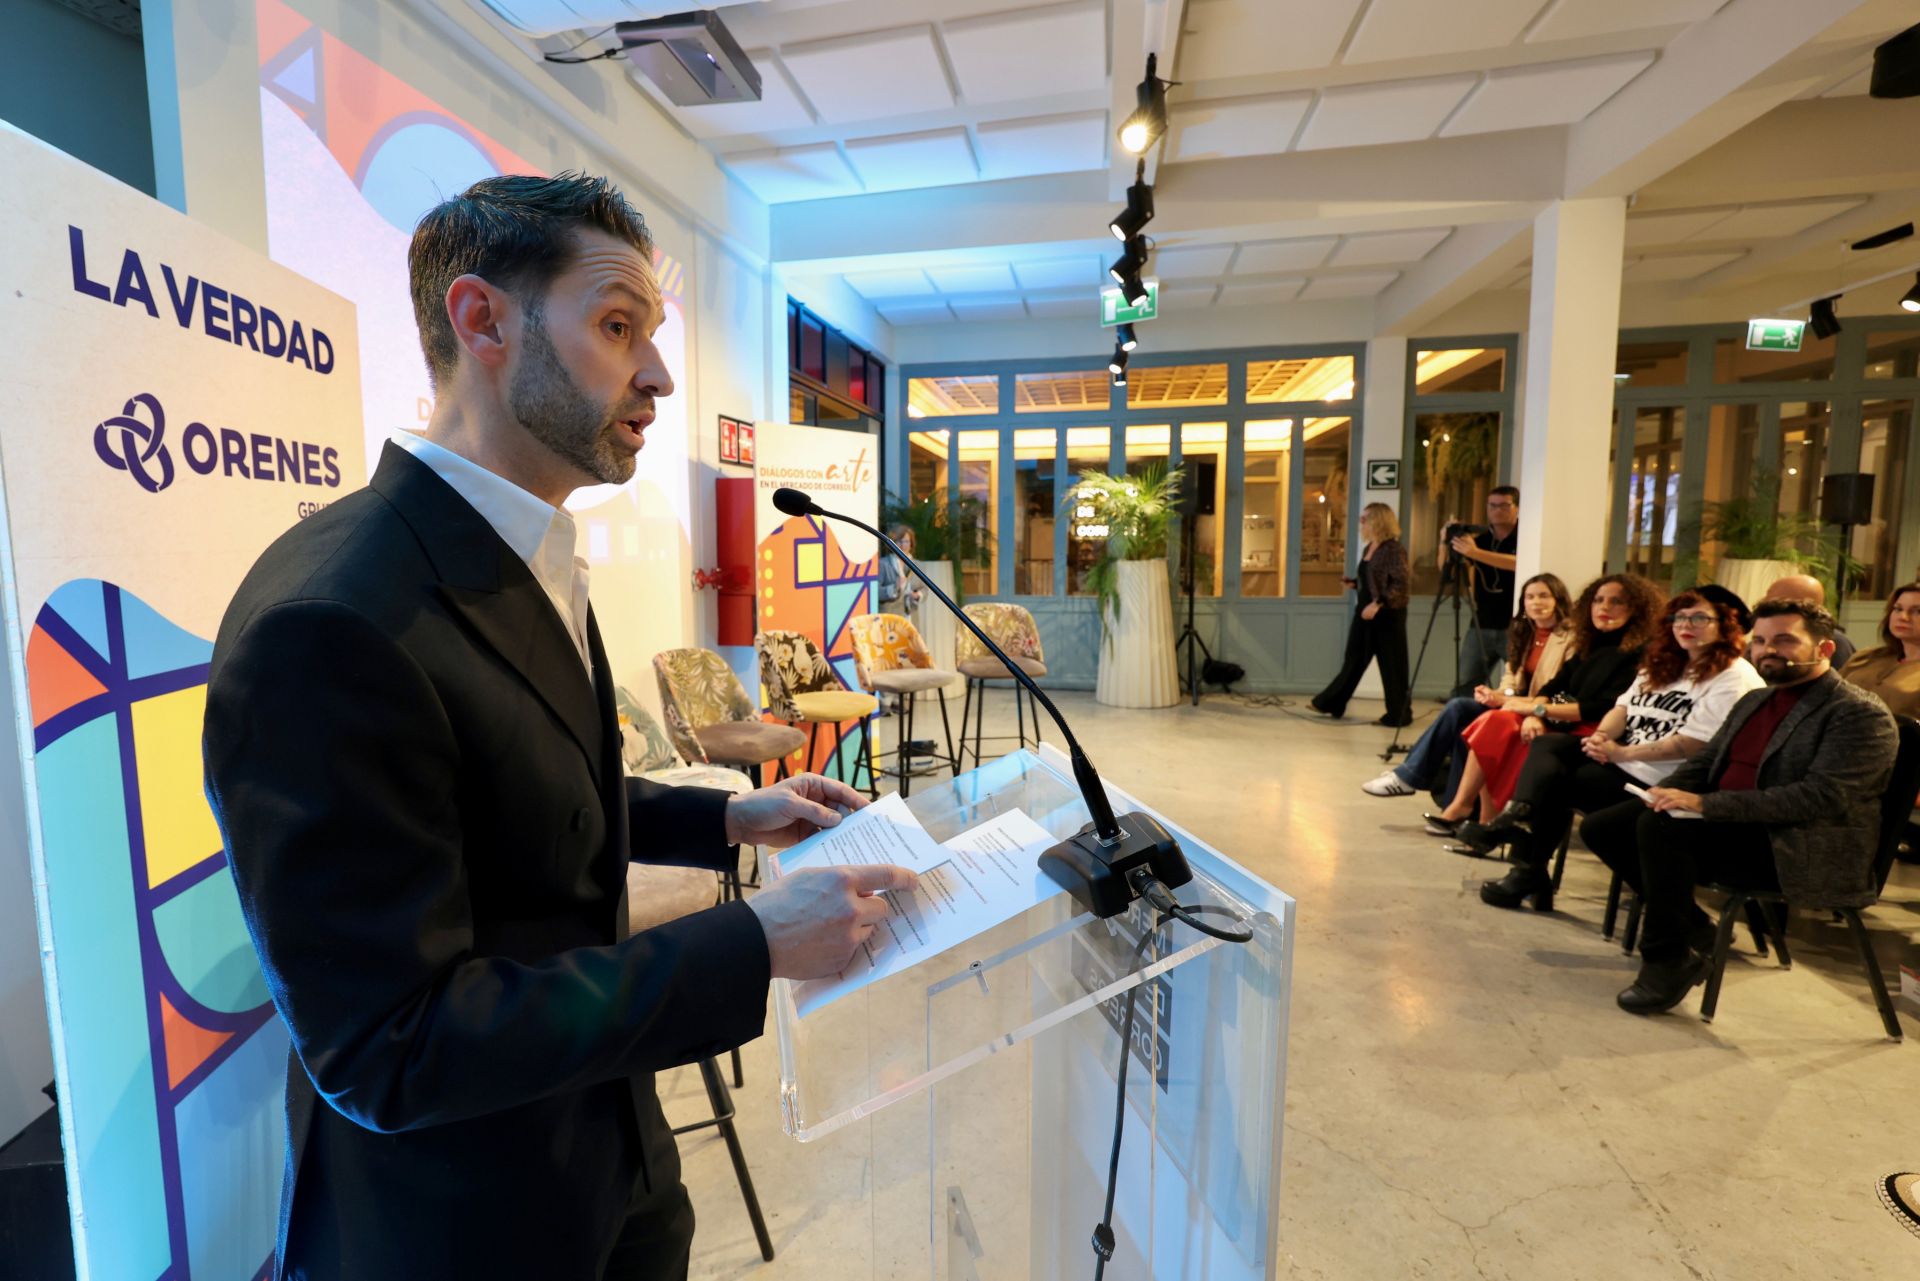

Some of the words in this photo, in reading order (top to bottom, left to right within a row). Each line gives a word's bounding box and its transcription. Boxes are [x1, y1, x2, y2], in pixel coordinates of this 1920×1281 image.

[68, 224, 160, 319] LA
[160, 262, 335, 375] VERDAD
[182, 422, 341, 488] ORENES
[826, 448, 873, 493] arte
[760, 480, 769, 489] EN
[771, 481, 778, 489] EL
